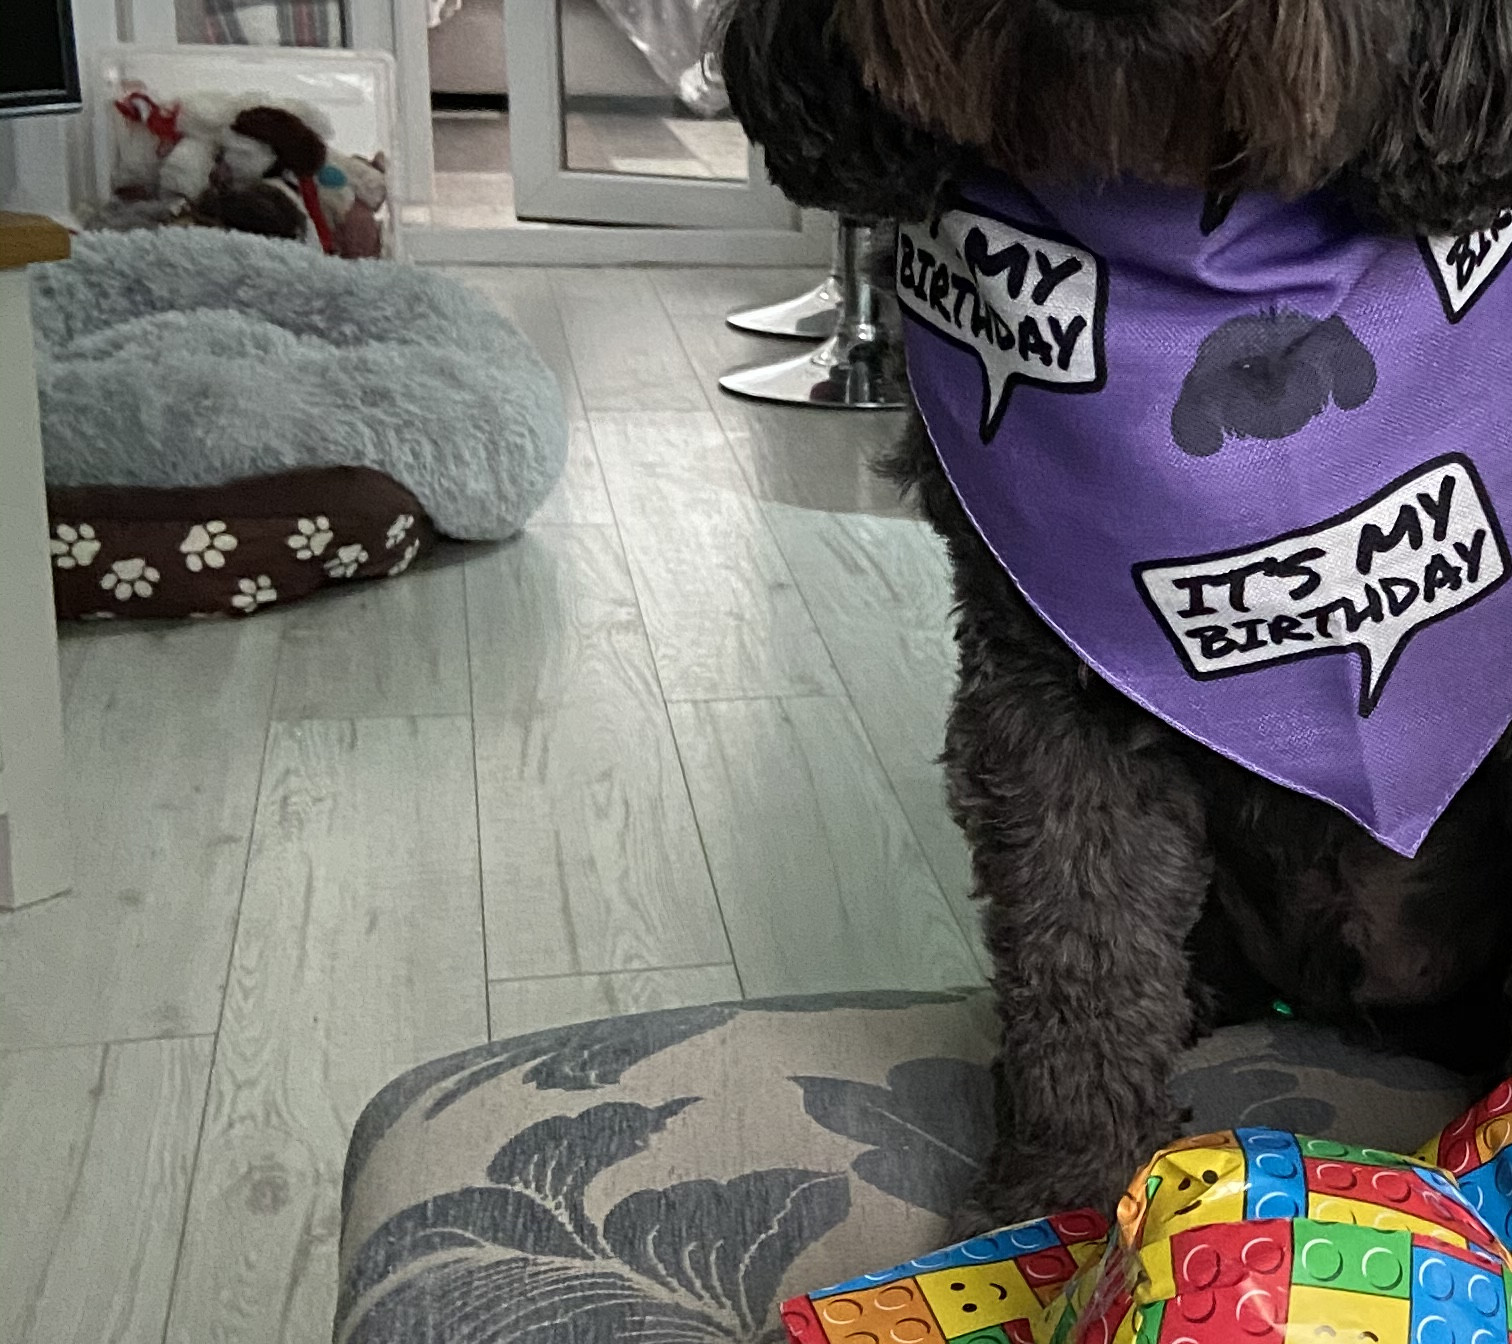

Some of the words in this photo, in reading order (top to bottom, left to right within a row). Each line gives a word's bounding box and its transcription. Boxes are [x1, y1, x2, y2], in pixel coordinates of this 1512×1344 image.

[900, 232, 1087, 371] BIRTHDAY
[964, 226, 1083, 306] MY
[1172, 547, 1327, 619] IT'S
[1356, 474, 1456, 575] MY
[1185, 528, 1487, 660] BIRTHDAY
